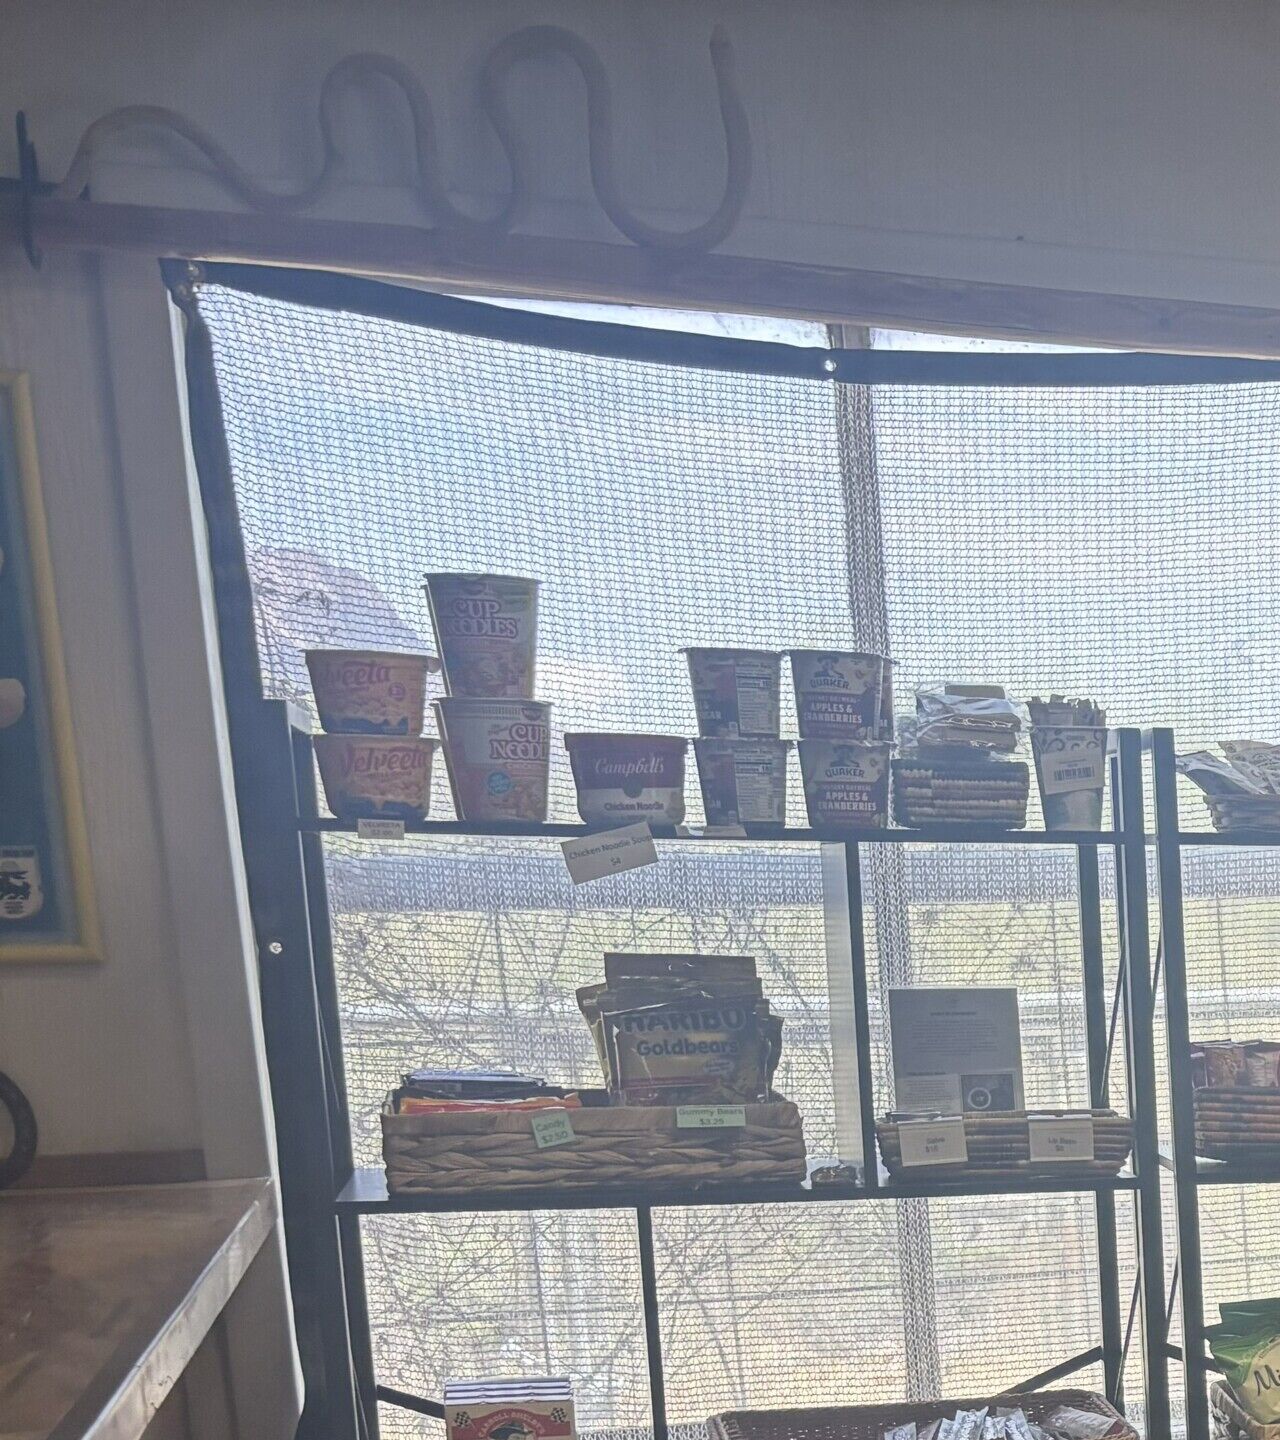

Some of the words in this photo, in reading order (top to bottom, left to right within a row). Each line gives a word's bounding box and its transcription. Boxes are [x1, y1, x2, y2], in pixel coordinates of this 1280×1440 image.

[595, 756, 665, 777] Campbell's
[825, 767, 865, 778] QUAKER
[825, 791, 860, 800] APPLES
[636, 1038, 739, 1056] Goldbears
[679, 1108, 715, 1118] Gummy
[717, 1107, 744, 1116] Bears
[536, 1119, 565, 1133] Candy
